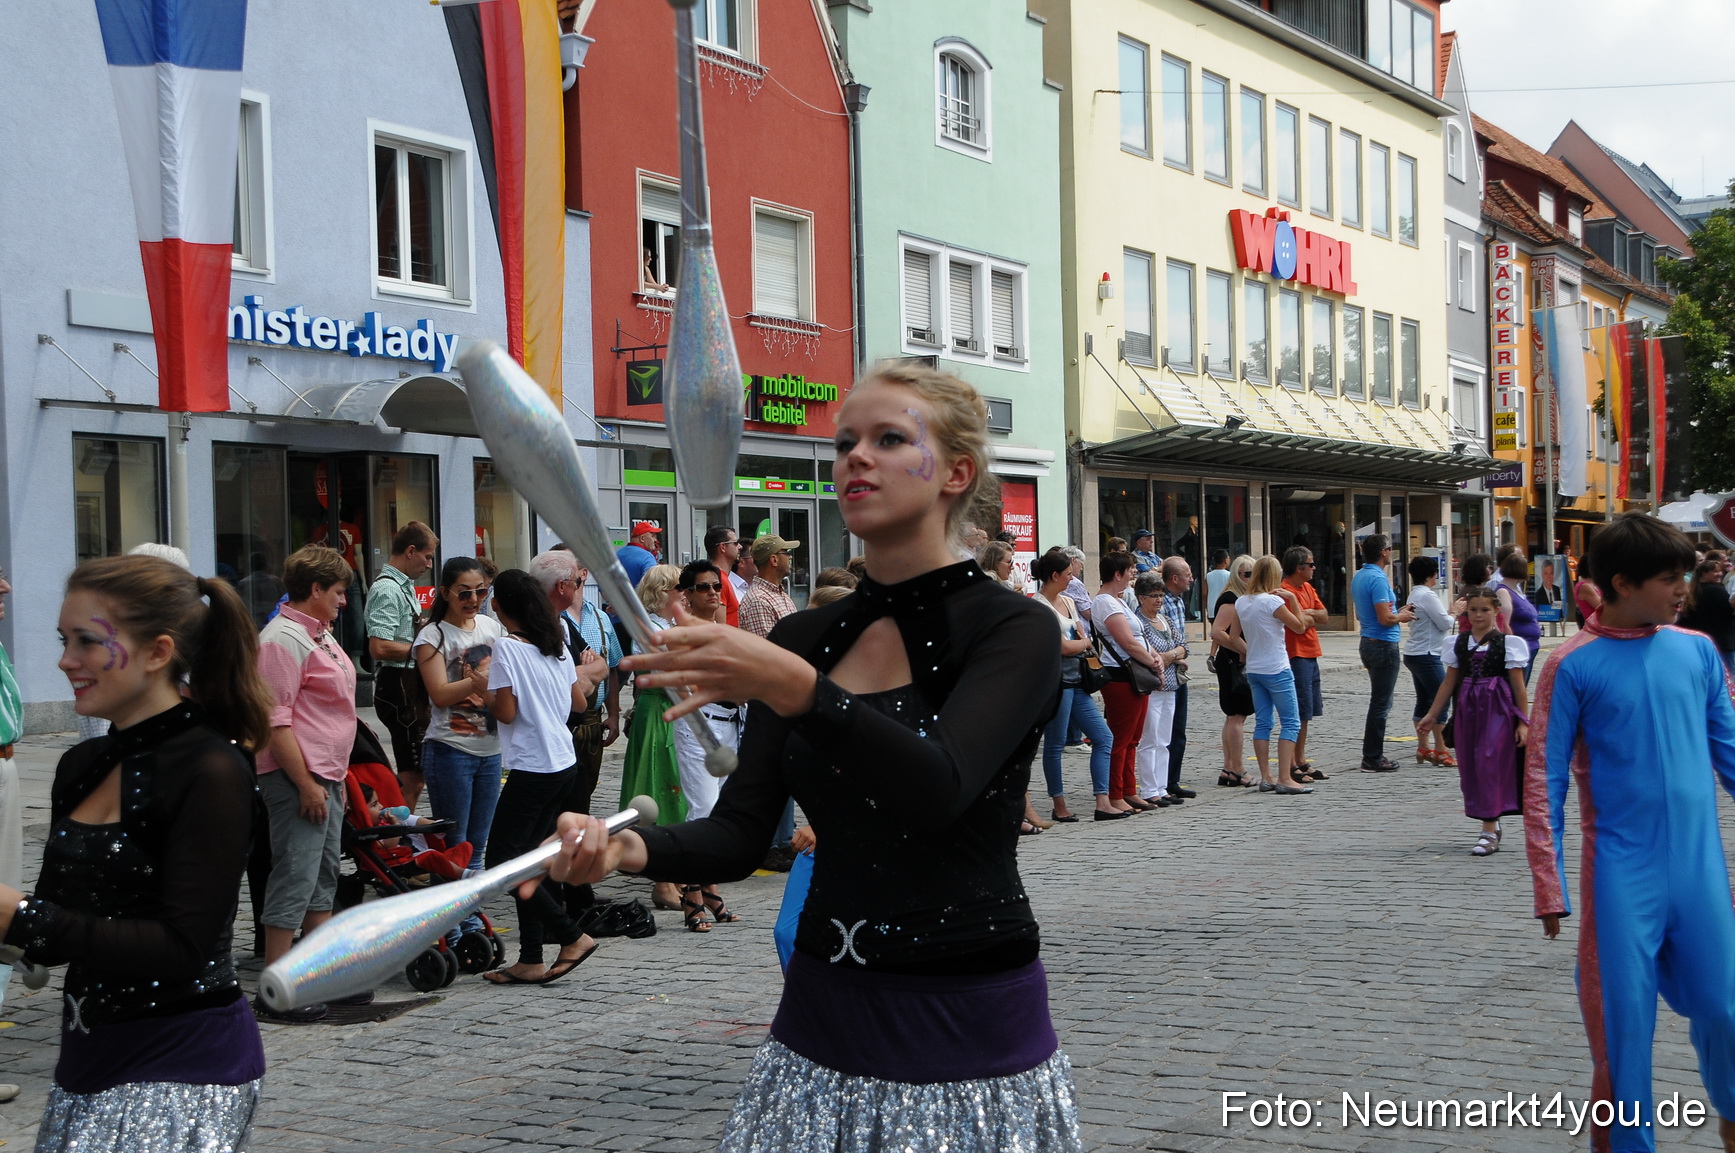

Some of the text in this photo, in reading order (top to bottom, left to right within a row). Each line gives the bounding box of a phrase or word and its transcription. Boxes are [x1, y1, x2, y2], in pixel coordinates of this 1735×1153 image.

[1229, 207, 1357, 297] WÖHRL
[1494, 244, 1512, 407] BÄCKEREI
[365, 311, 460, 373] lady
[761, 373, 838, 402] mobilcom
[761, 399, 808, 426] debitel
[1495, 414, 1516, 426] café
[1496, 436, 1516, 448] plank
[1003, 512, 1034, 524] RÄUMUNGS-
[1004, 524, 1033, 537] VERKAUF
